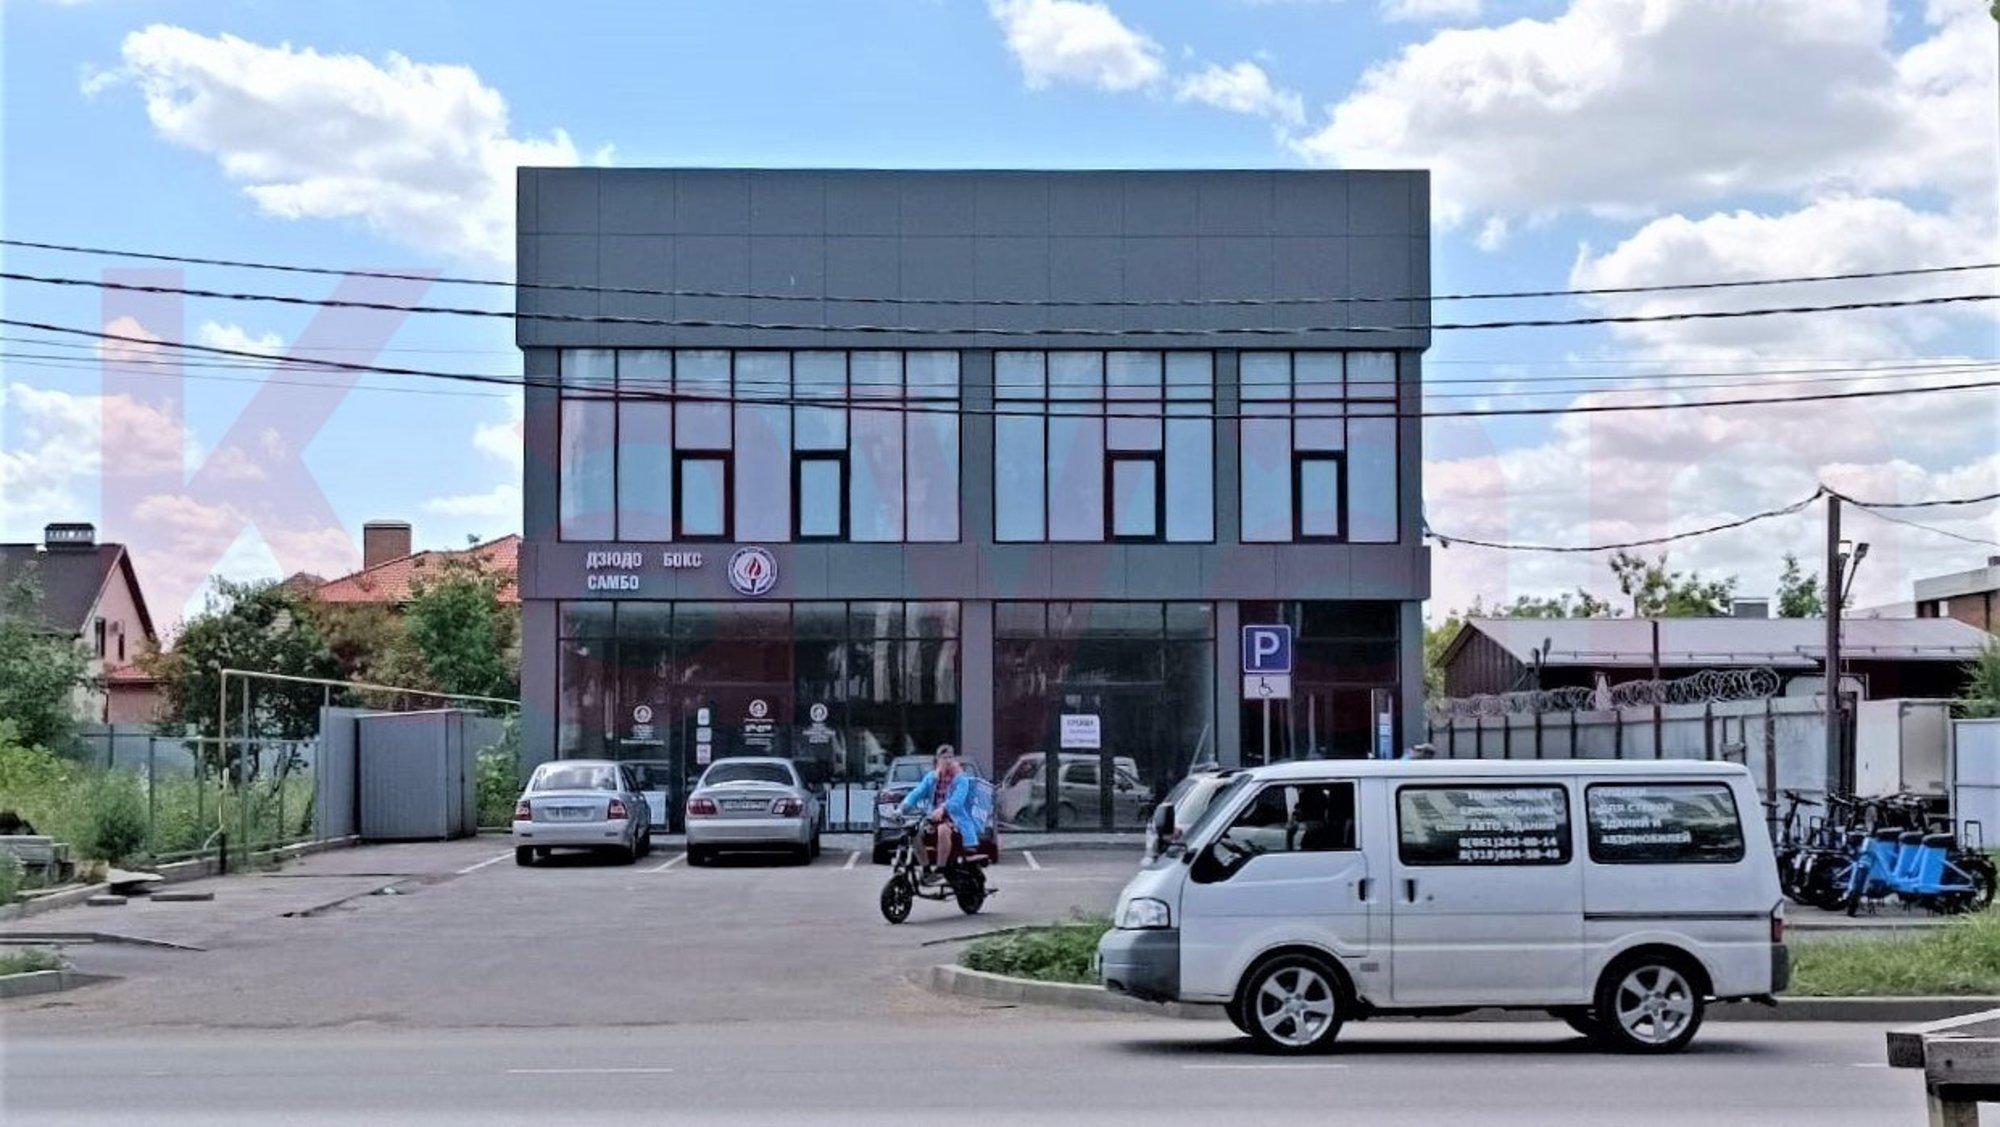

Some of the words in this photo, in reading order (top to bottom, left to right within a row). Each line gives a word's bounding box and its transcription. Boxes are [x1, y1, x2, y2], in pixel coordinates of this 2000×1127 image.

[586, 551, 642, 571] ДЗЮДО
[662, 552, 703, 569] БОКС
[586, 574, 640, 590] САМБО
